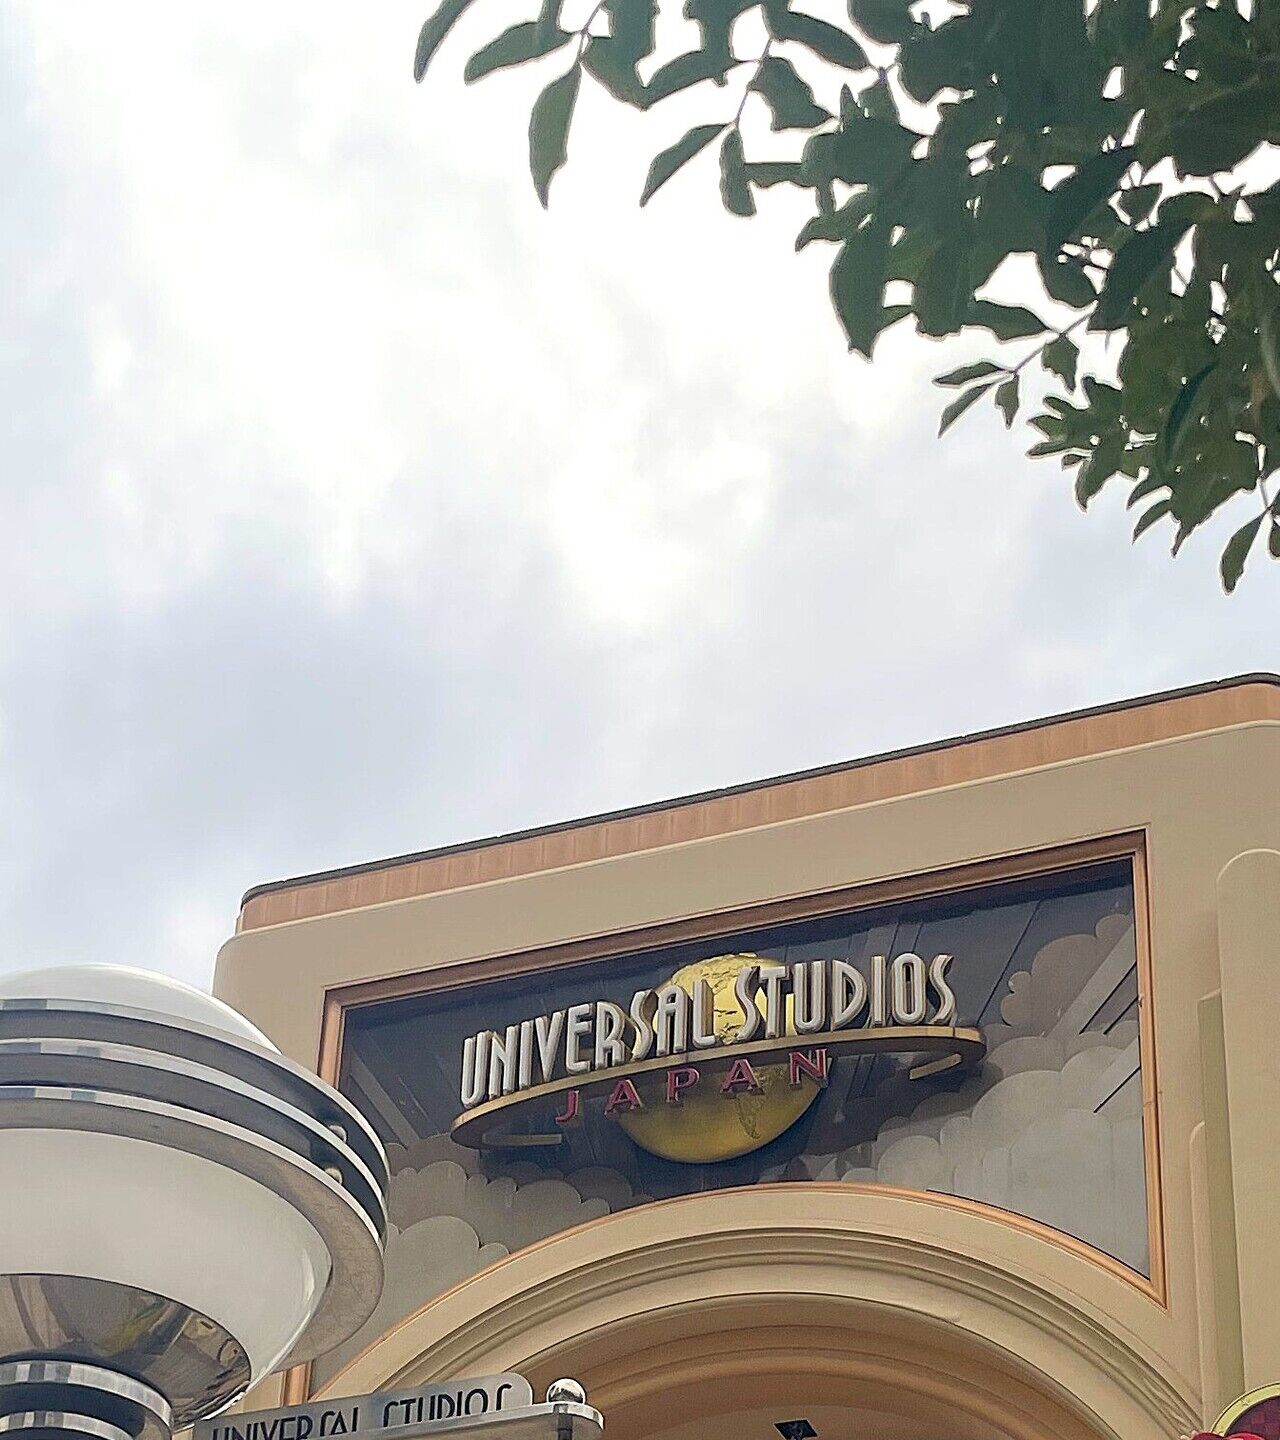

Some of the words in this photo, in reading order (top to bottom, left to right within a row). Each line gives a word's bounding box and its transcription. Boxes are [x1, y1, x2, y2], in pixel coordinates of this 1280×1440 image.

[461, 978, 719, 1108] UNIVERSAL
[735, 952, 955, 1043] STUDIOS
[555, 1048, 829, 1124] JAPAN
